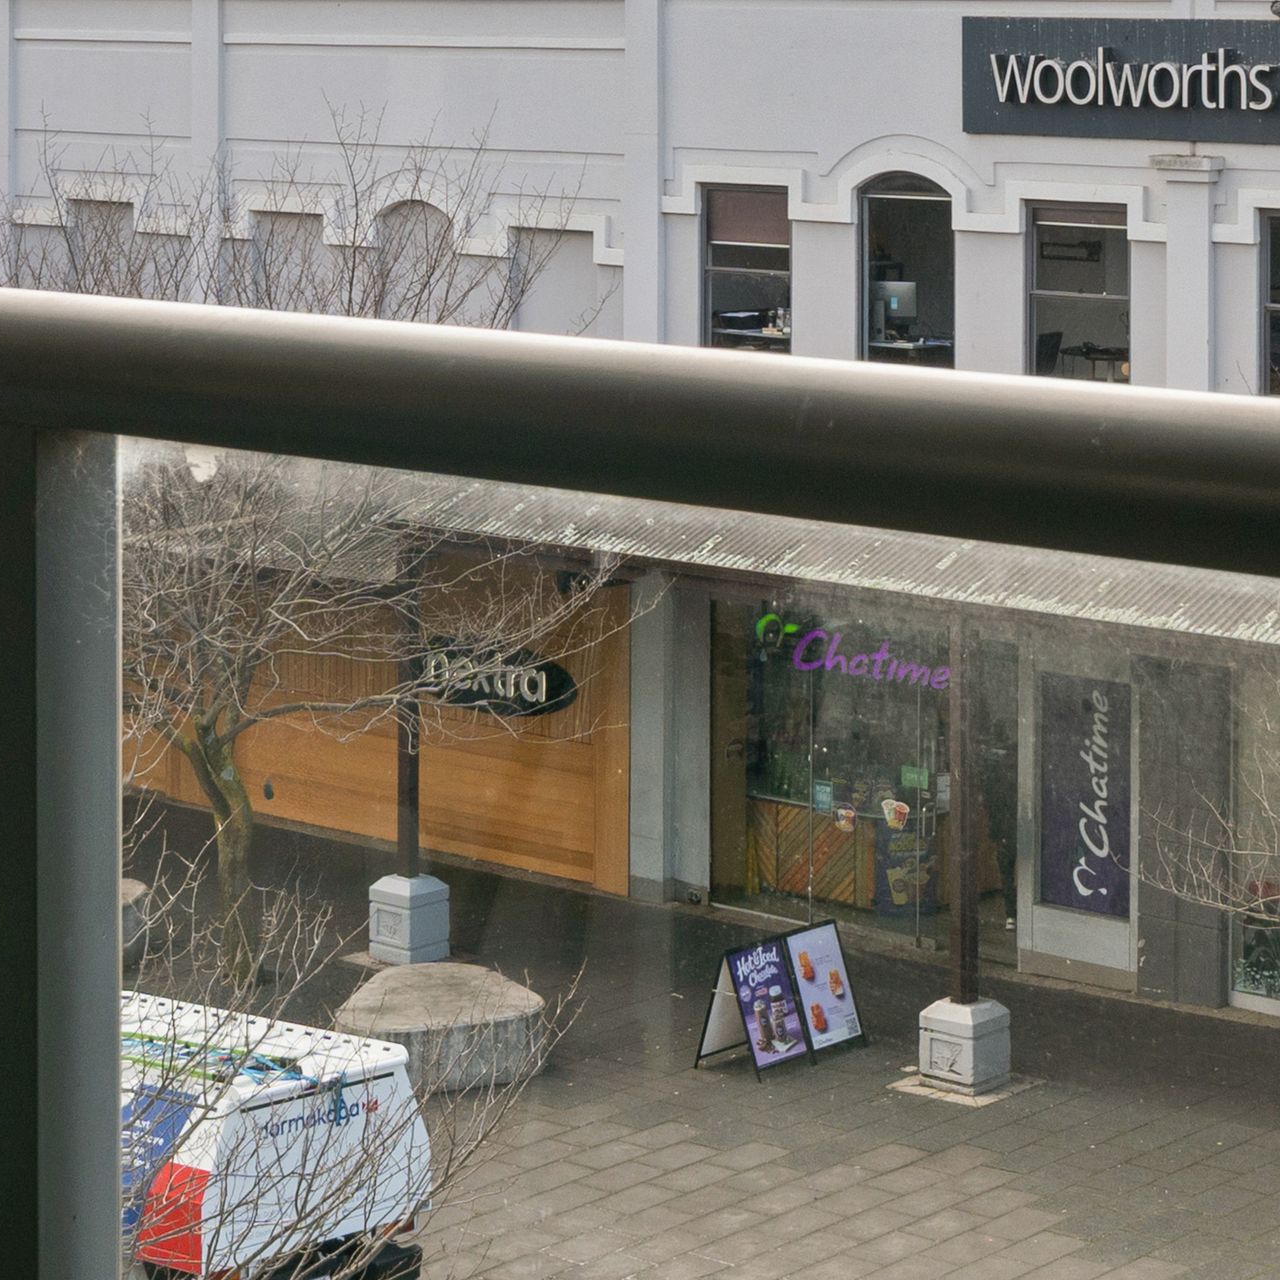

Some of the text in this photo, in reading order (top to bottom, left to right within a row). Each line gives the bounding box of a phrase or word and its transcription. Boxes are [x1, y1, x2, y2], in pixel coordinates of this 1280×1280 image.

[990, 46, 1272, 111] Woolworths
[425, 651, 547, 703] nextra
[792, 627, 952, 689] Chatime
[1078, 689, 1110, 858] Chatime
